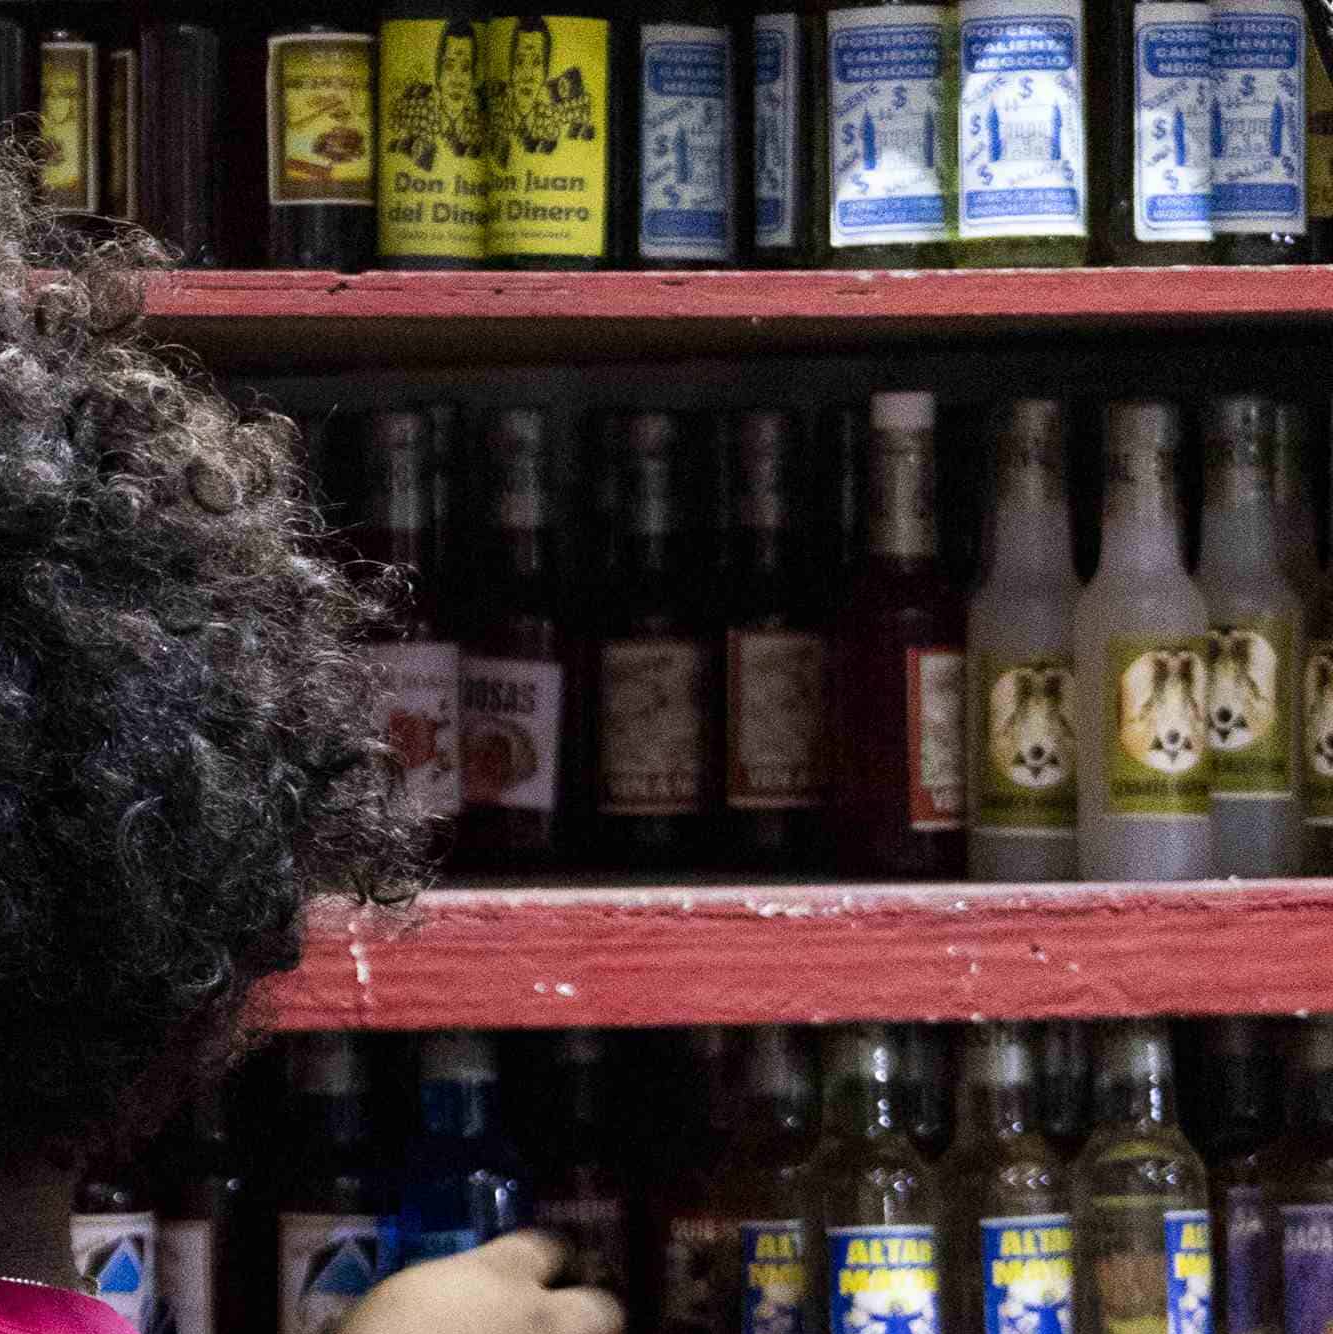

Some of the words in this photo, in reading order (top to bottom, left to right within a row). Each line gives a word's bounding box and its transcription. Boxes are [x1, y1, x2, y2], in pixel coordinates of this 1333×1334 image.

[395, 172, 444, 193] Don
[525, 169, 587, 193] Juan
[507, 199, 590, 222] Dinero
